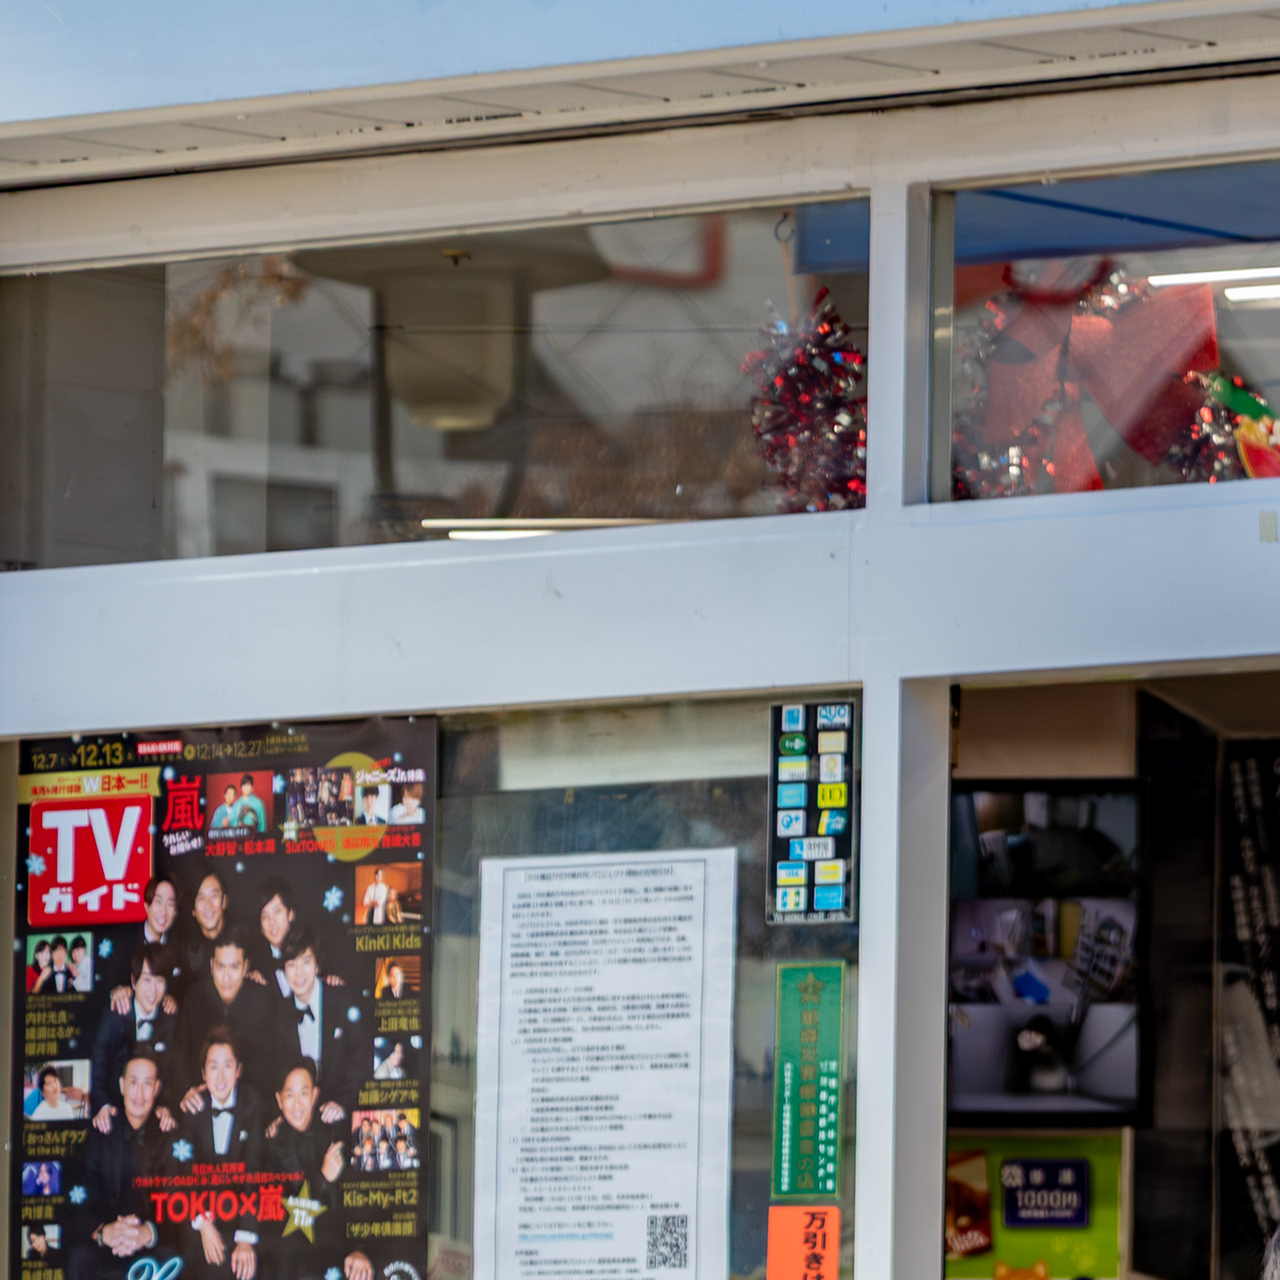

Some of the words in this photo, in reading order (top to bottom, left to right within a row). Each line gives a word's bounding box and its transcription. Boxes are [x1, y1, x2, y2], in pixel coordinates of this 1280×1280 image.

[162, 775, 204, 831] 嵐
[43, 806, 142, 884] TV
[42, 884, 141, 914] ガイド
